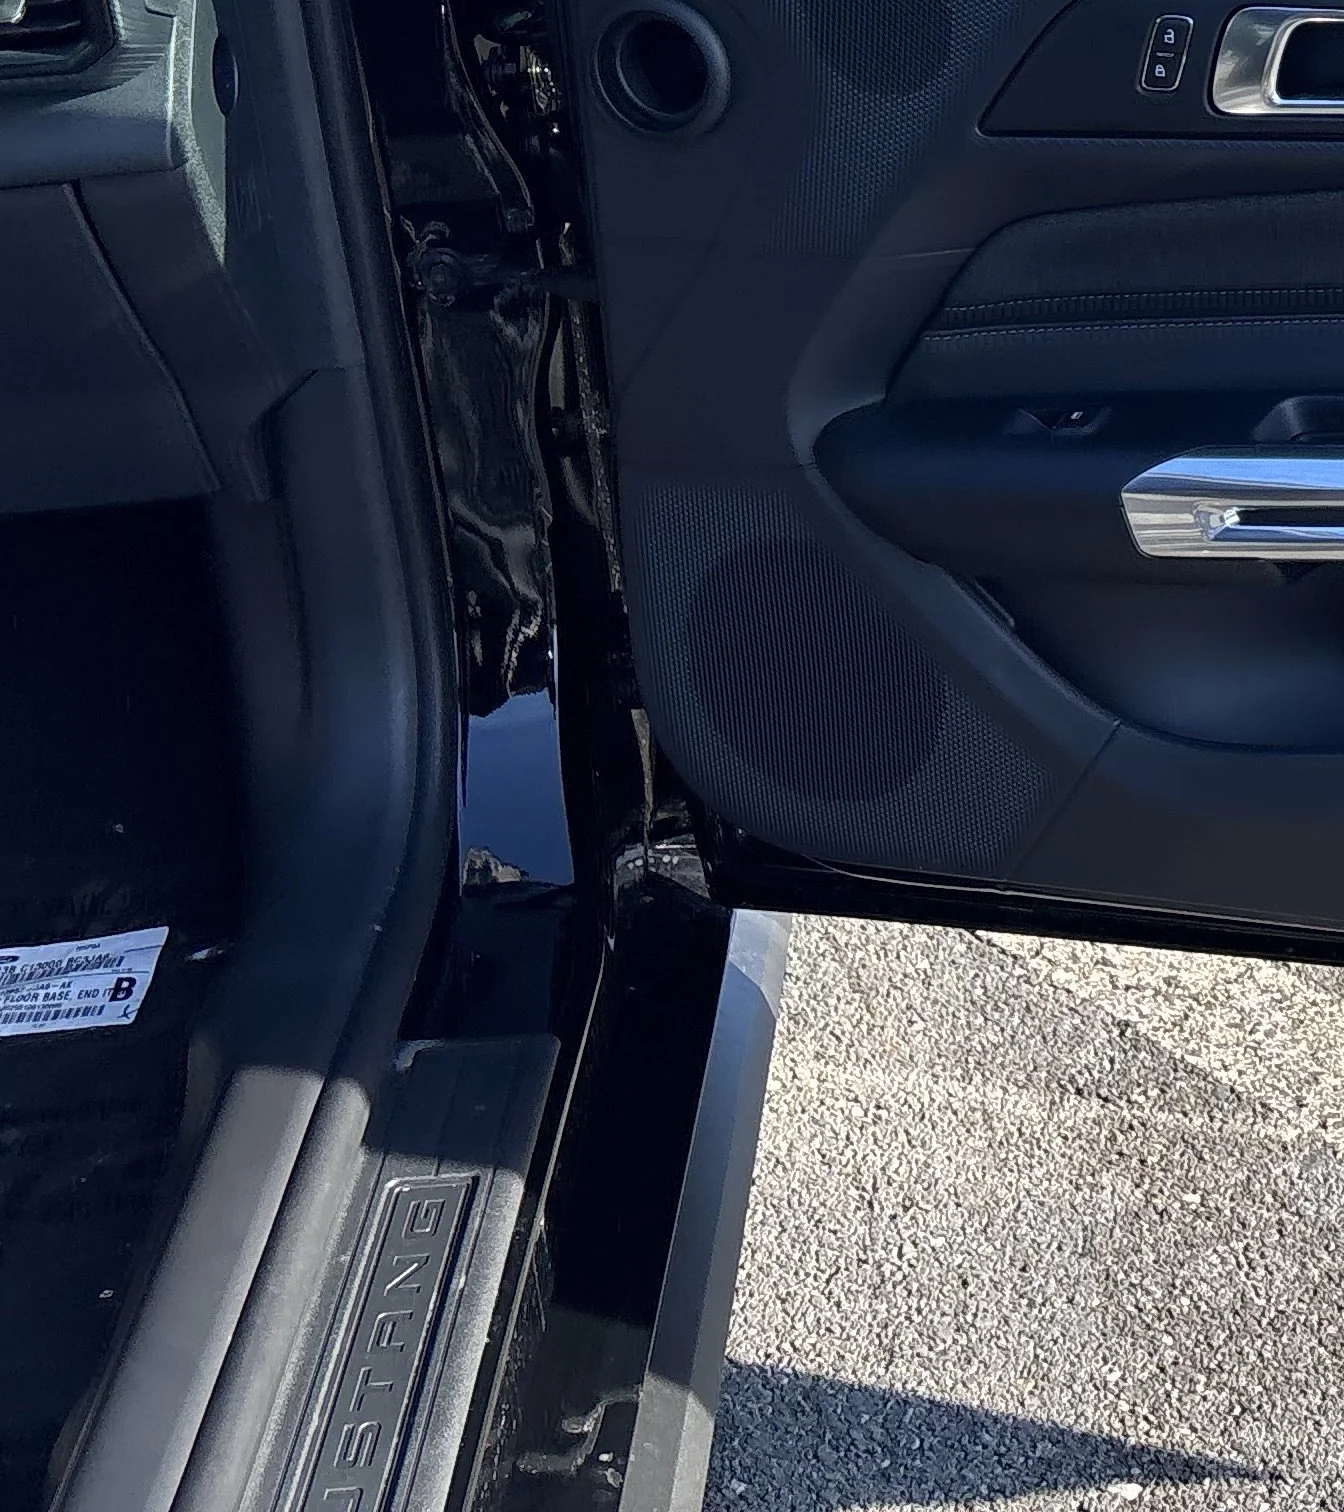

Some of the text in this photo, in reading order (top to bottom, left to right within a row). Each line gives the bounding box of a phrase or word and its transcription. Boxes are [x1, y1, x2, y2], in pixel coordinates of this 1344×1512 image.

[4, 992, 40, 1004] FLOOR
[77, 988, 100, 999] END
[108, 976, 137, 1002] B
[322, 1198, 446, 1512] USTANG
